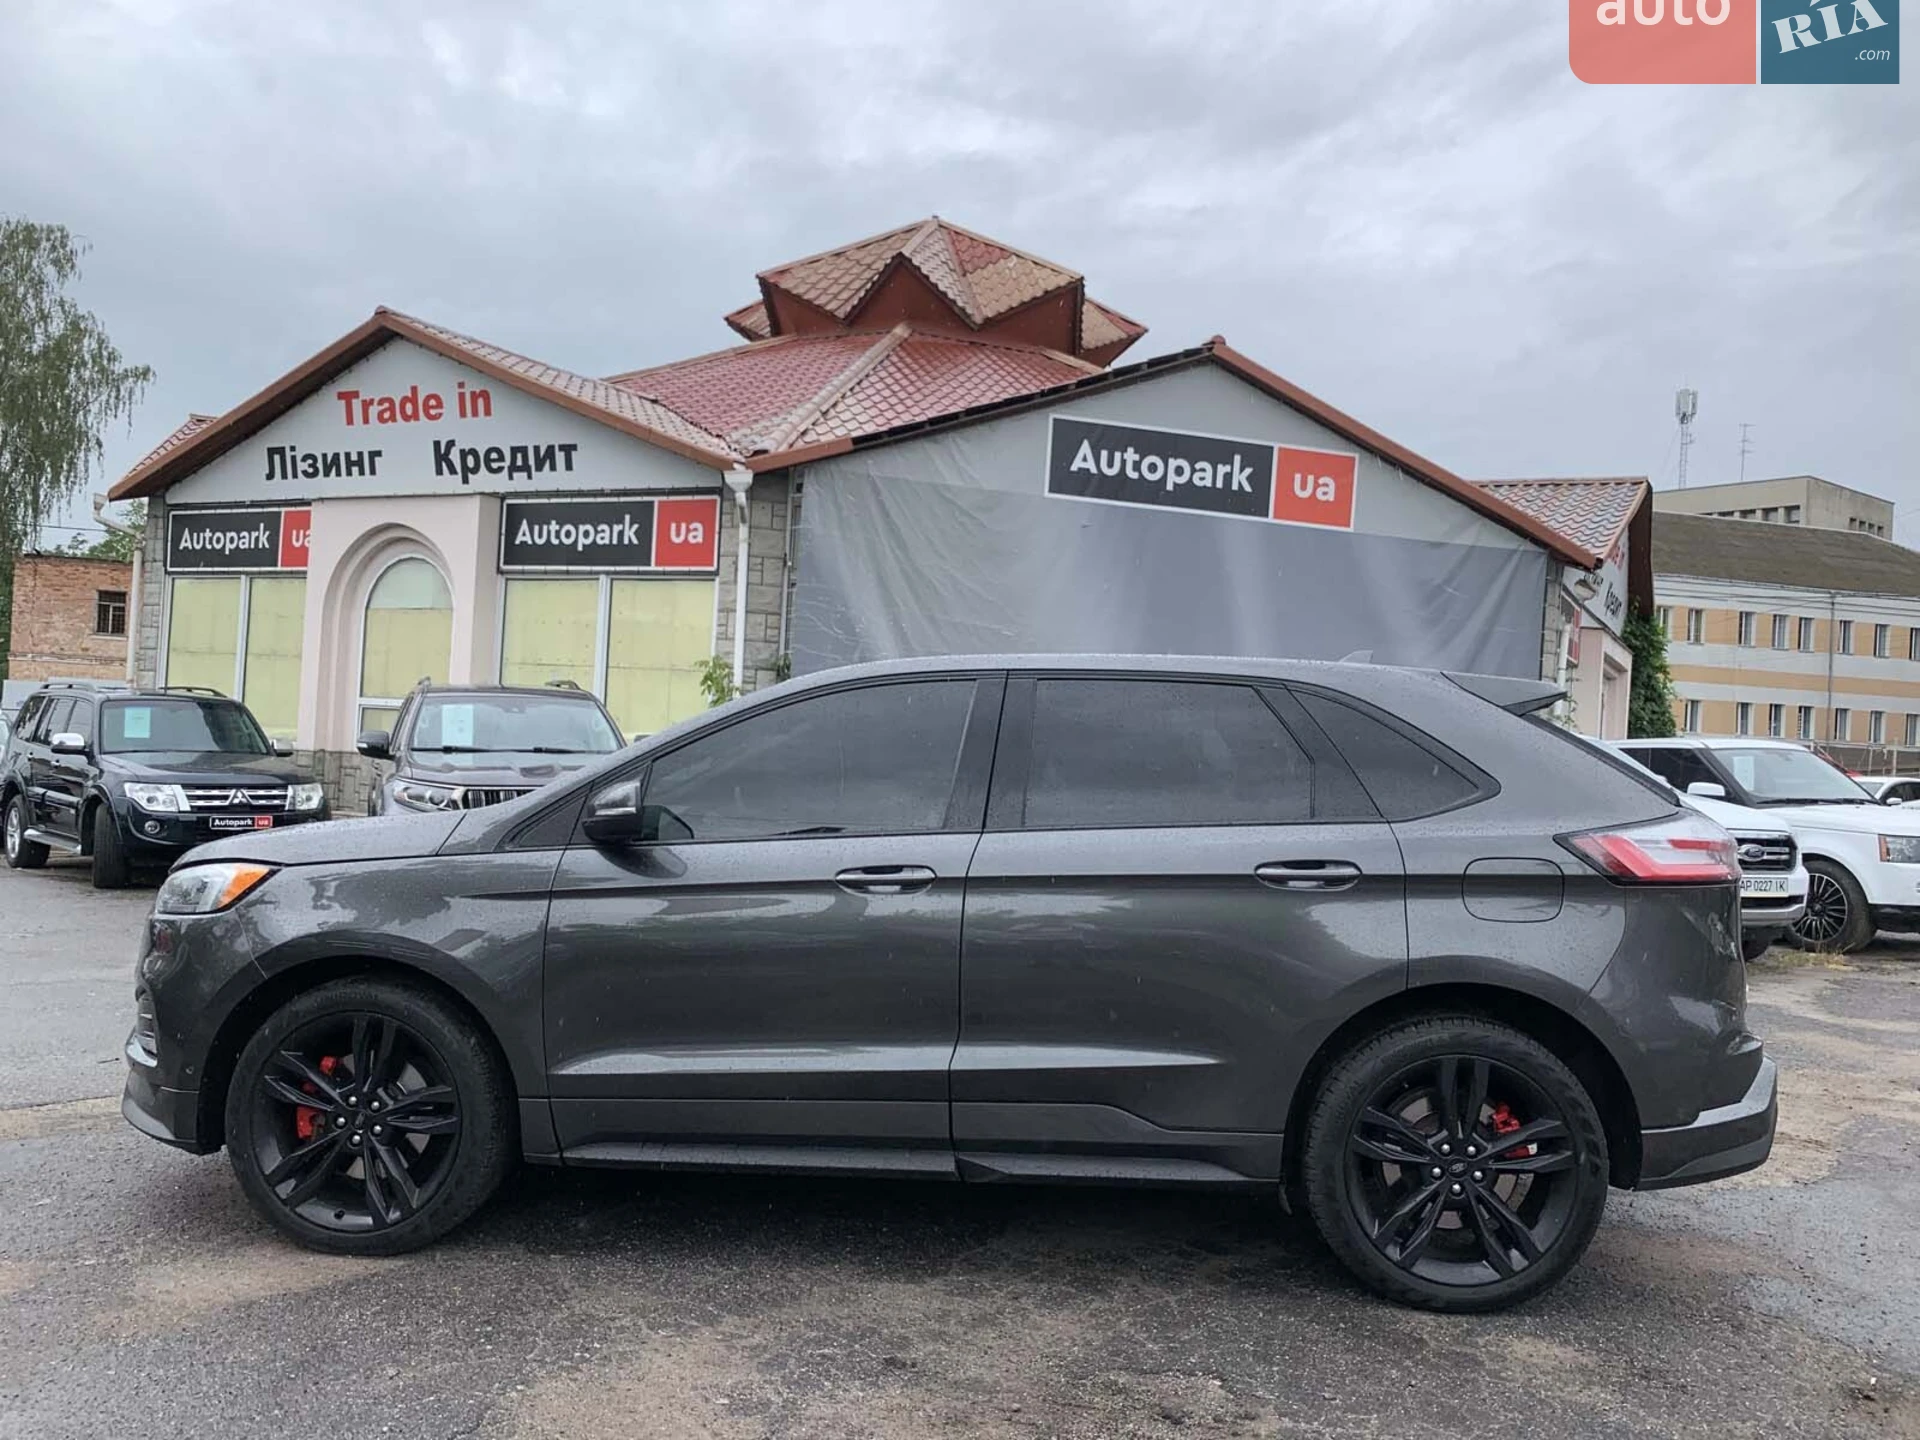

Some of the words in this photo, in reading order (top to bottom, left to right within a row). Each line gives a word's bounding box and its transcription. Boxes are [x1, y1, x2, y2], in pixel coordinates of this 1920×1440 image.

[337, 385, 444, 426] Trade
[457, 381, 493, 418] in
[265, 445, 383, 481] Лізинг
[433, 439, 578, 485] Кредит
[1070, 438, 1254, 493] Autopark
[1293, 472, 1336, 502] ua
[179, 522, 271, 555] Autopark
[514, 513, 640, 551] Autopark
[669, 521, 704, 545] ua
[213, 818, 253, 827] Autopark
[1740, 880, 1752, 892] AP
[1753, 880, 1773, 892] 0227
[1775, 880, 1786, 892] IK
